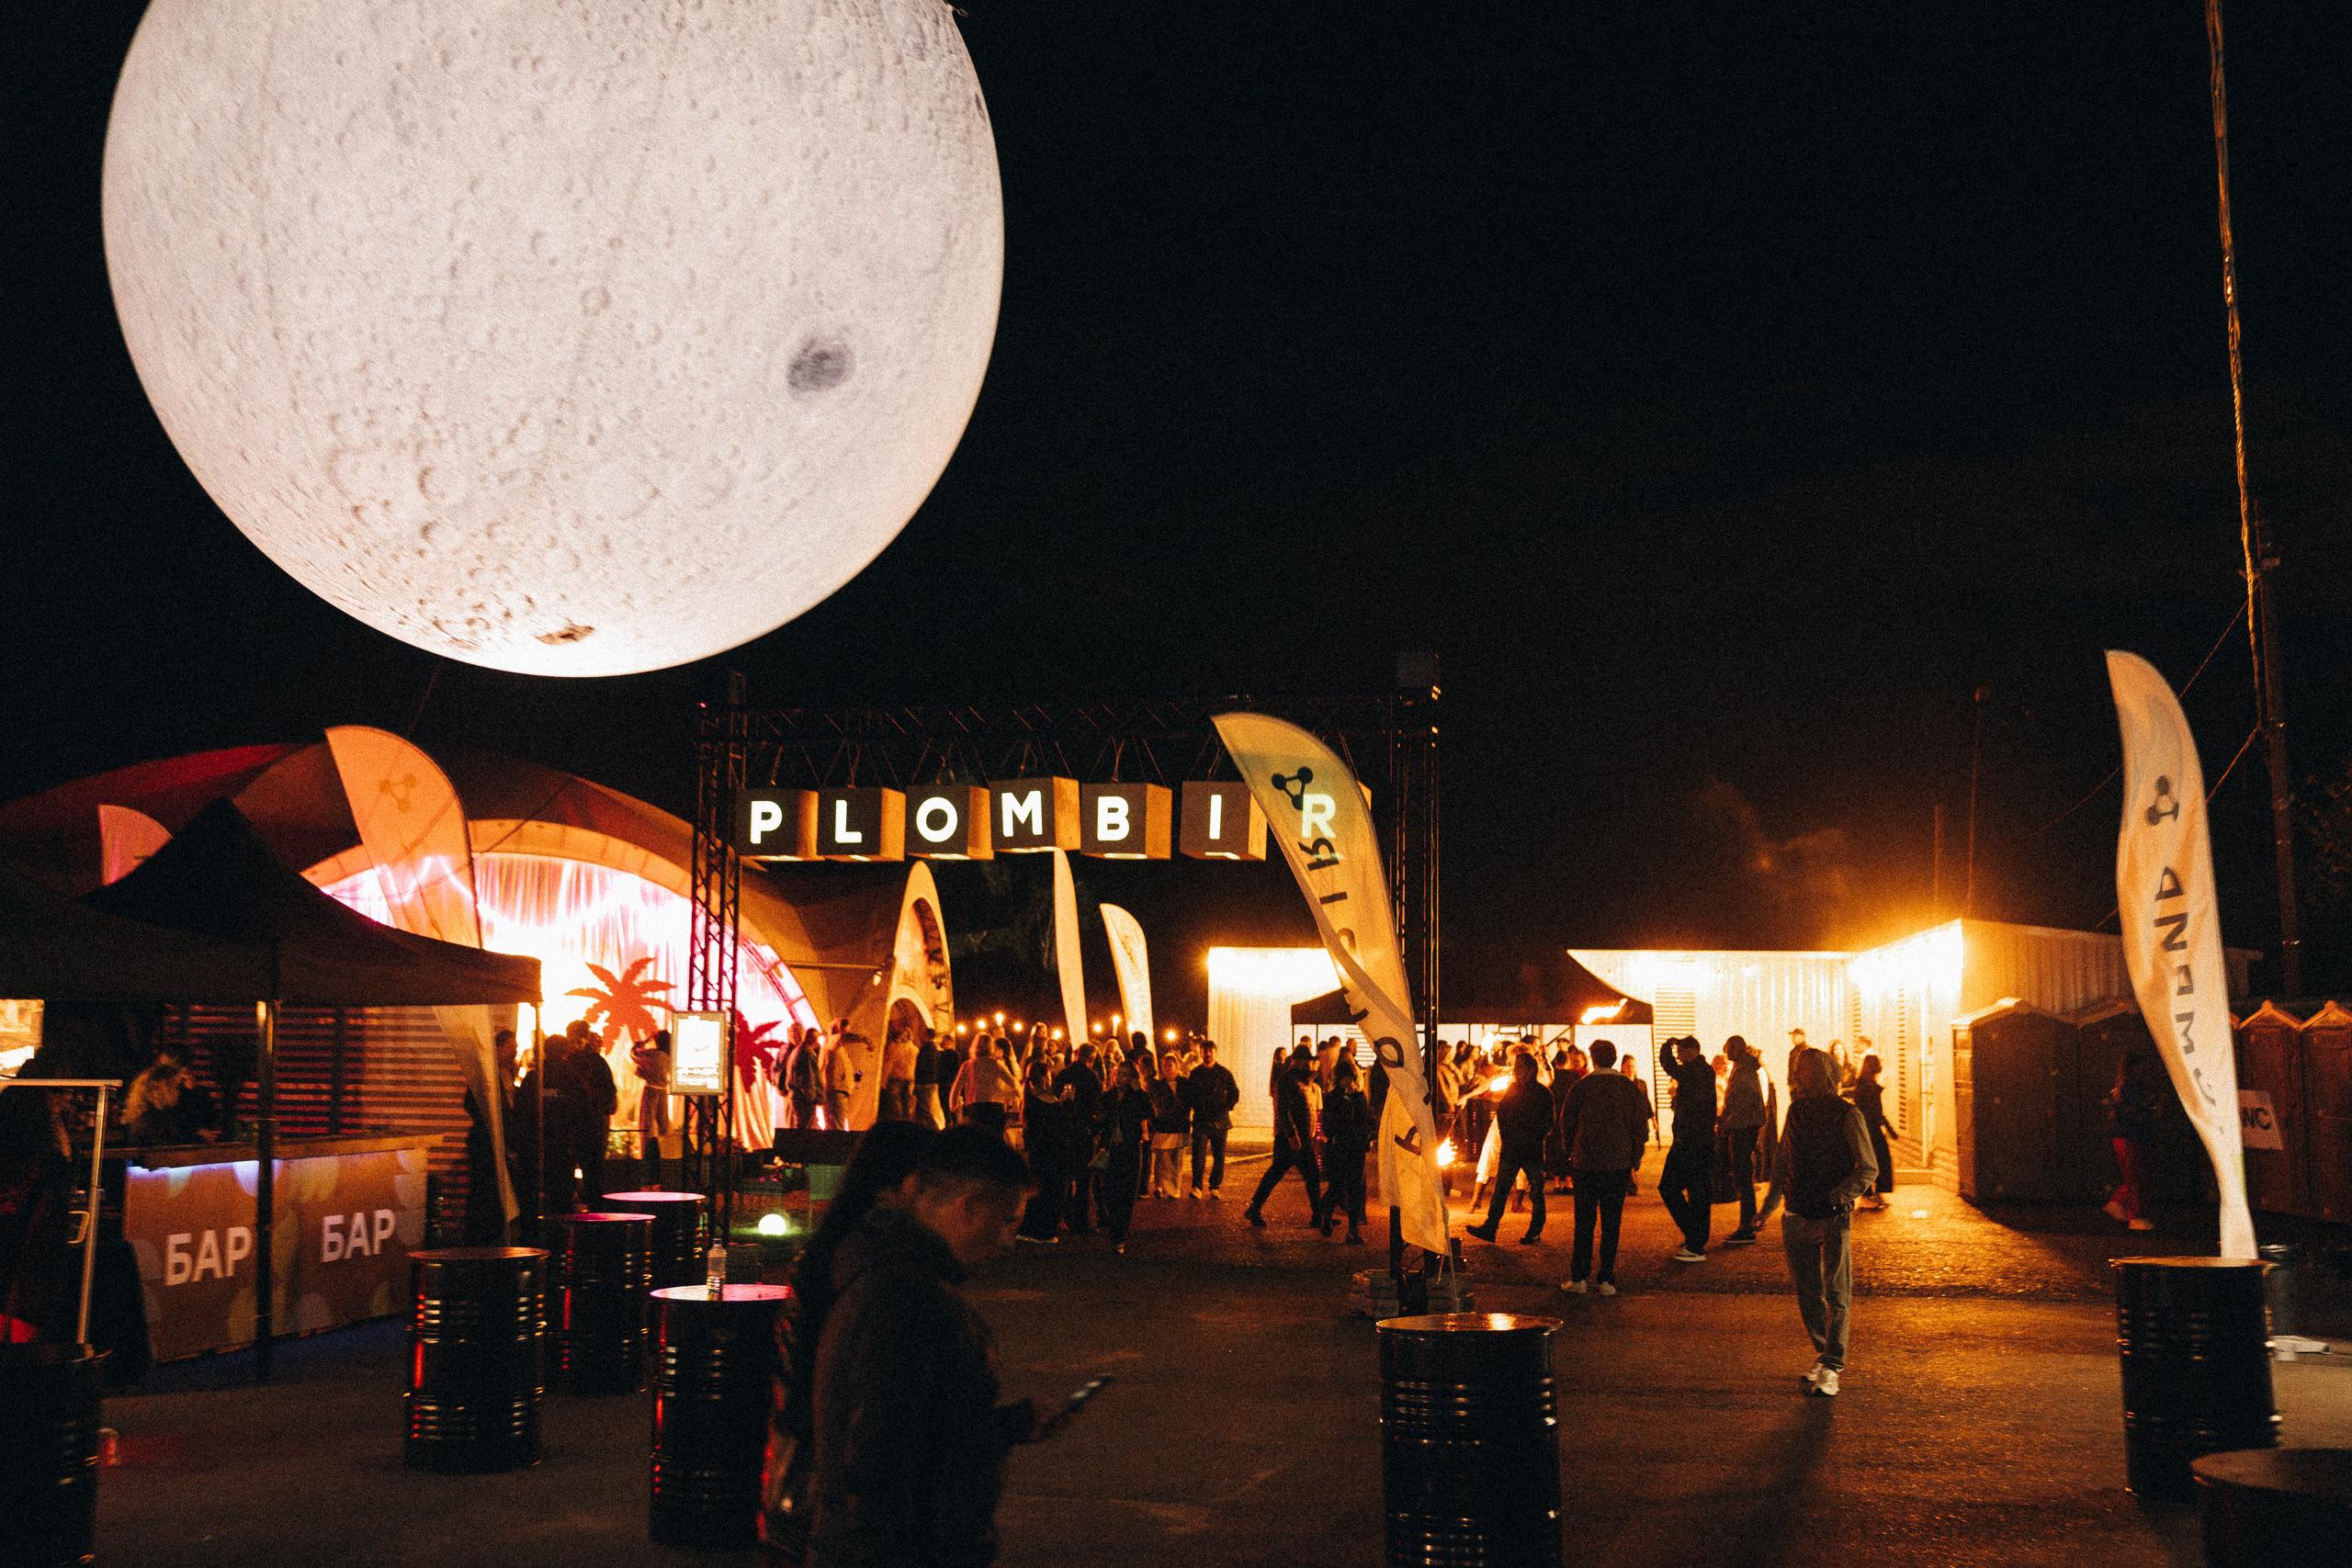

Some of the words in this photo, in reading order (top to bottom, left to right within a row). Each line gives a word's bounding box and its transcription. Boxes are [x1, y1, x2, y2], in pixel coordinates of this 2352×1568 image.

[750, 790, 1337, 844] PLOMBIR
[164, 1225, 253, 1286] БАР
[322, 1208, 396, 1264] БАР
